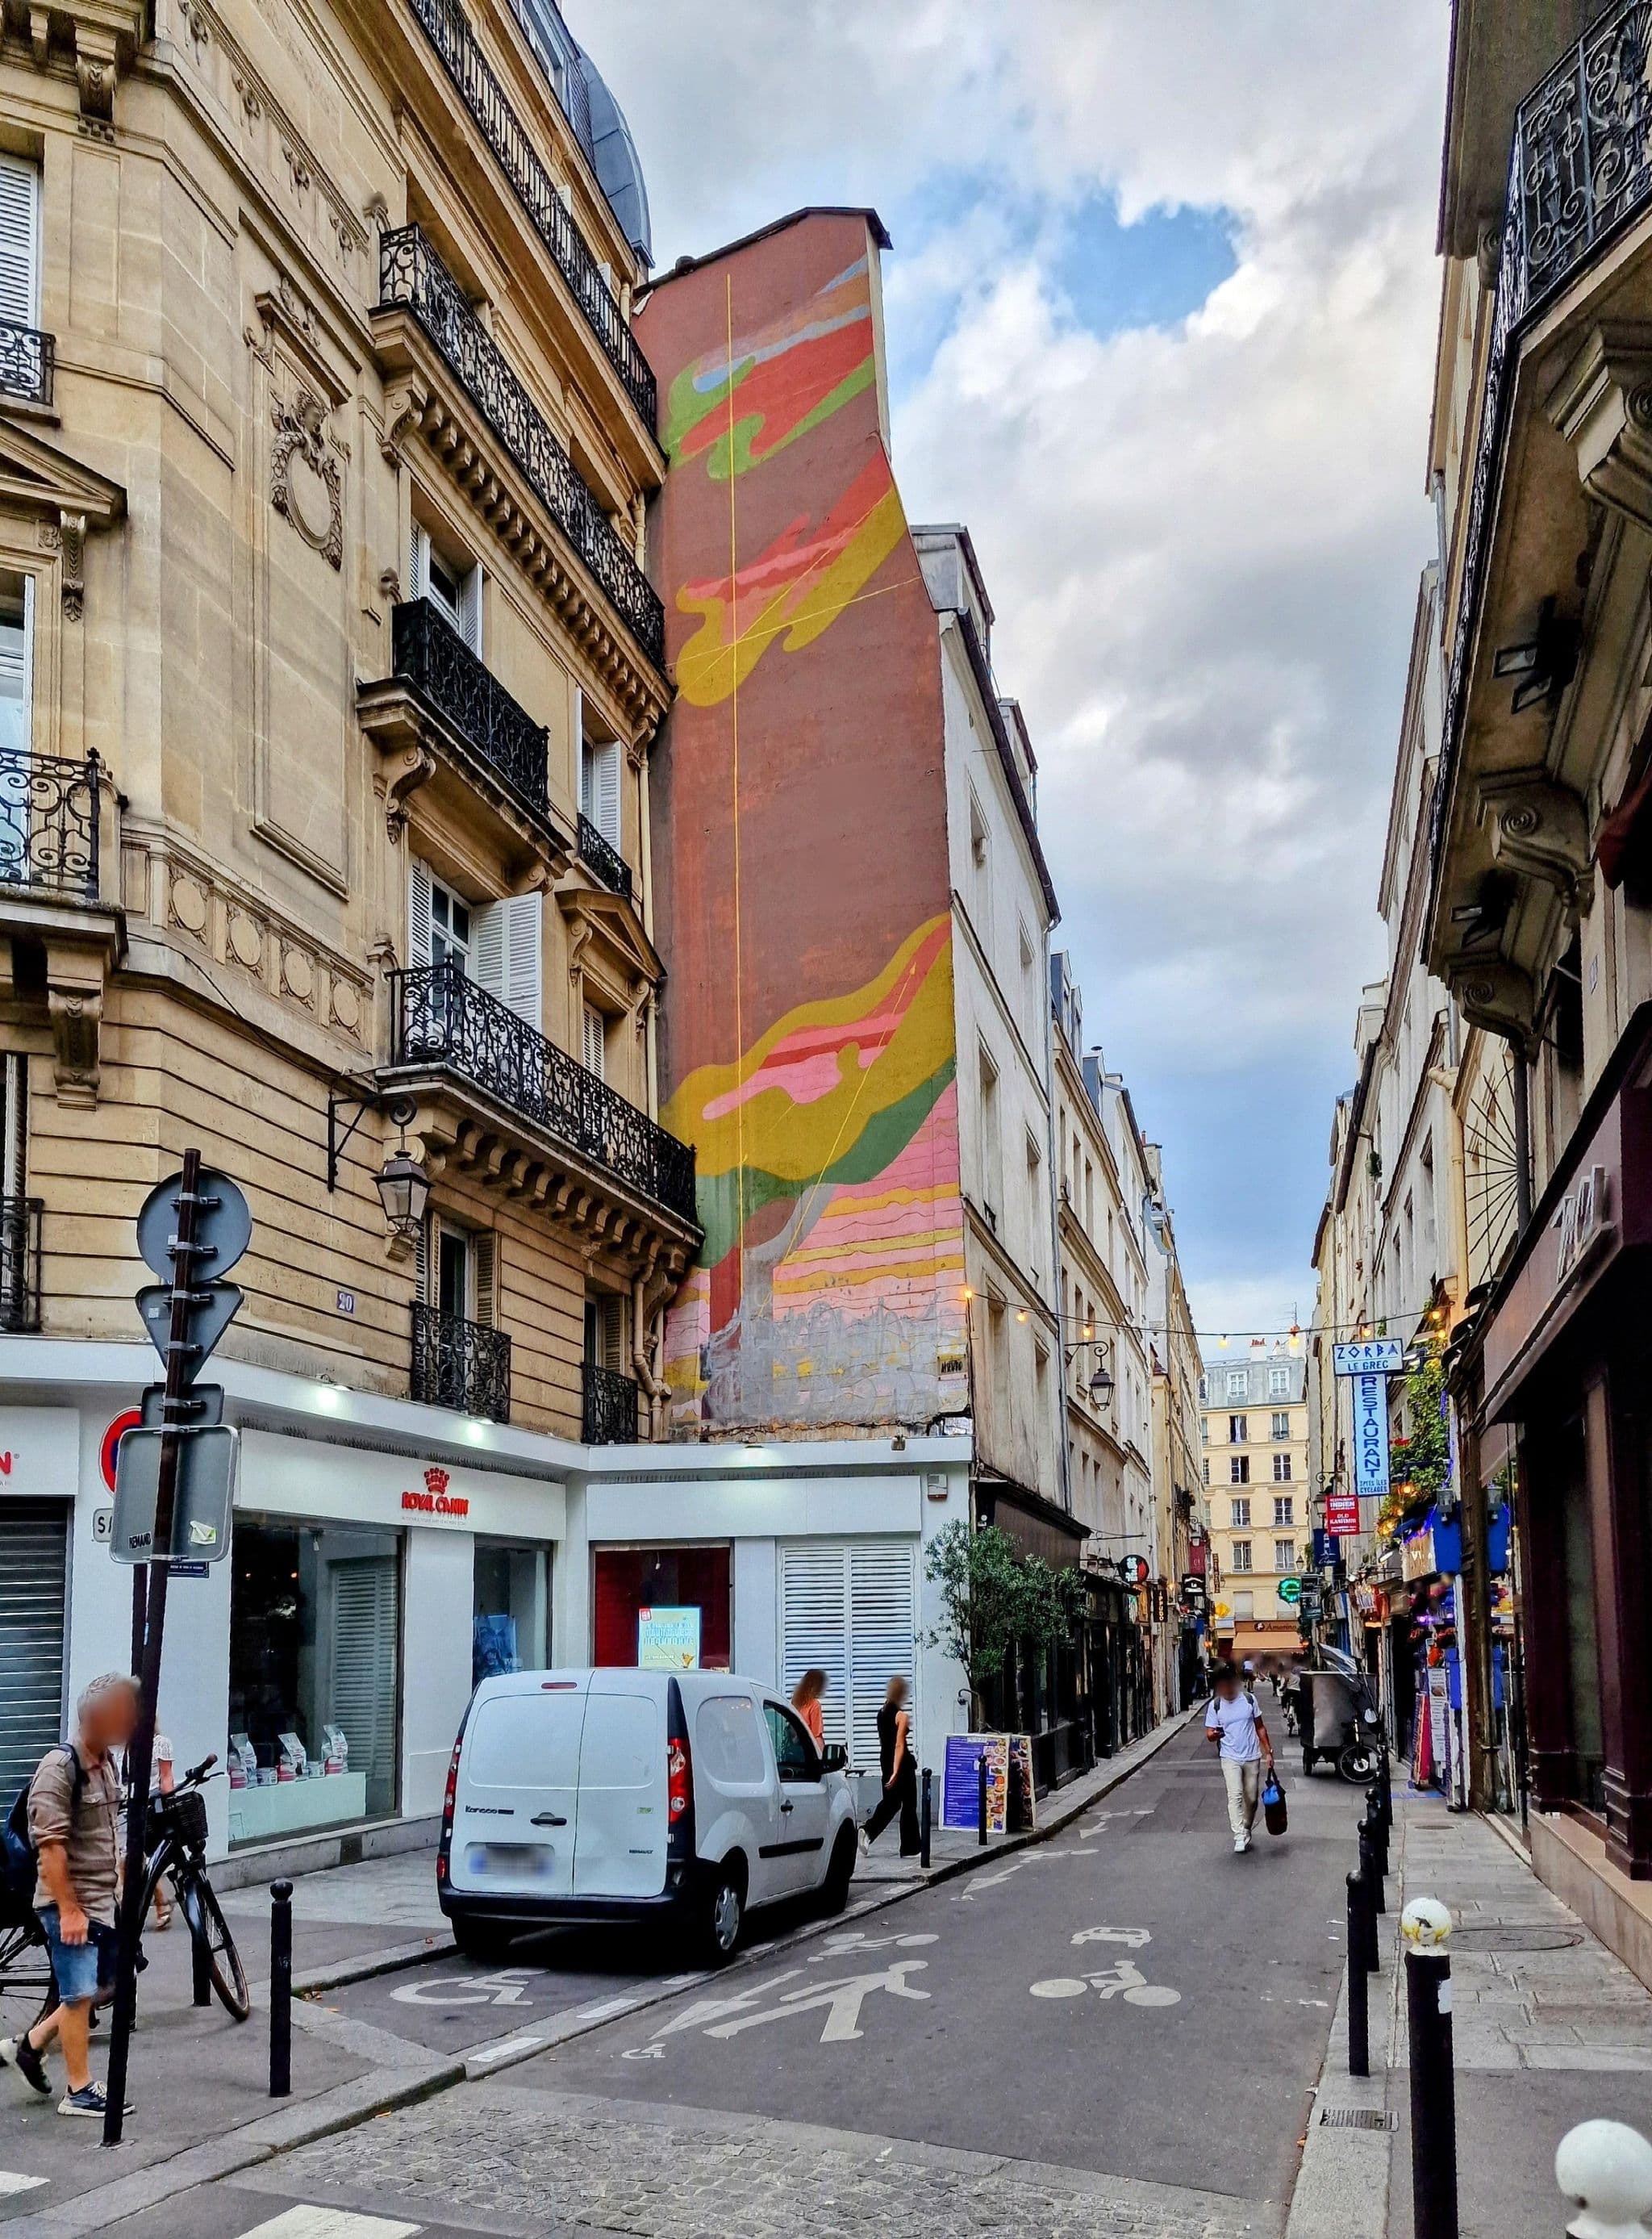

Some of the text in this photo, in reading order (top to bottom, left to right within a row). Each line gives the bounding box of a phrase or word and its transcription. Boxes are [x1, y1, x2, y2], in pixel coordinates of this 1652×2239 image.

[339, 1293, 353, 1311] 20
[1337, 1343, 1398, 1360] ZORBA
[1348, 1360, 1389, 1372] LE GREC
[1361, 1376, 1381, 1478] RESTAURANT
